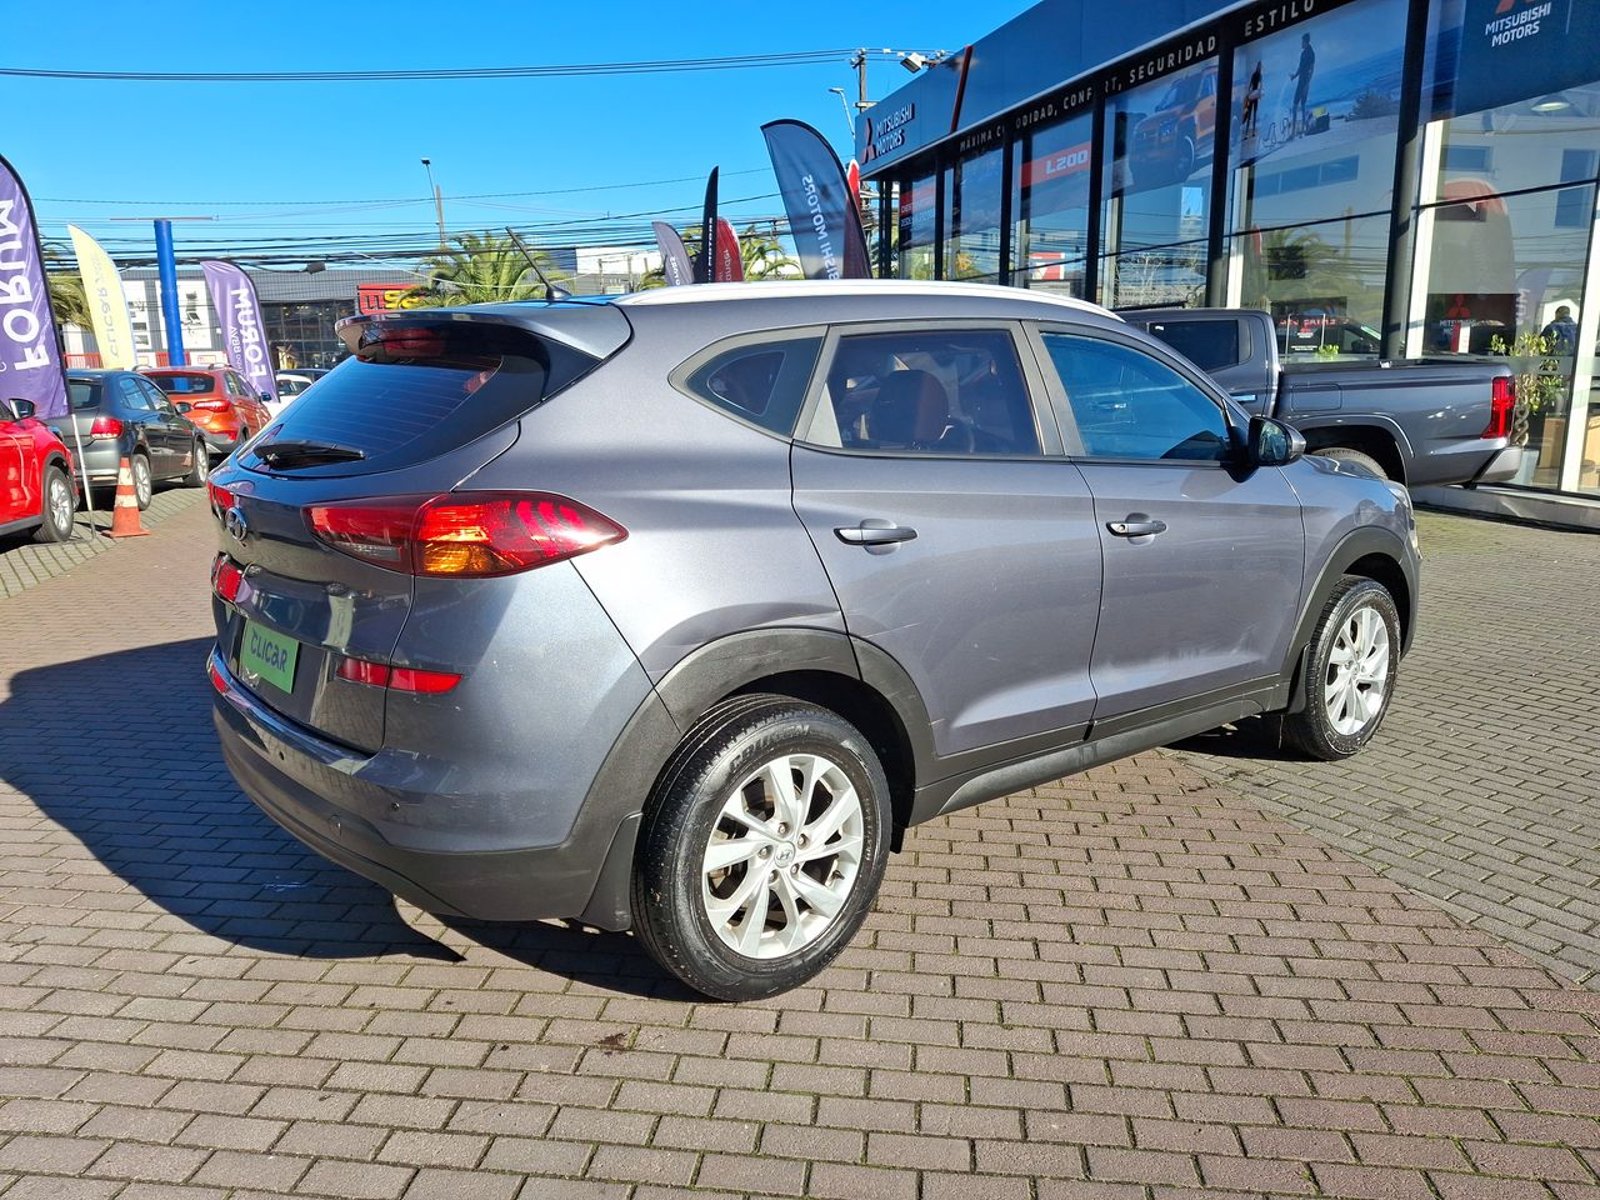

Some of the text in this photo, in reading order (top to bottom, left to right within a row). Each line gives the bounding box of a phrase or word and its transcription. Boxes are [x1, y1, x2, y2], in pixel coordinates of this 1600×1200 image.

[1485, 2, 1552, 36] MITSUBISHI
[1491, 20, 1541, 47] MOTORS
[996, 104, 1058, 138] CODIDAD,
[1129, 35, 1216, 84] SEGURIDAD
[876, 103, 914, 137] MITSUBISHI
[876, 129, 905, 155] MOTORS
[1045, 150, 1088, 175] L200
